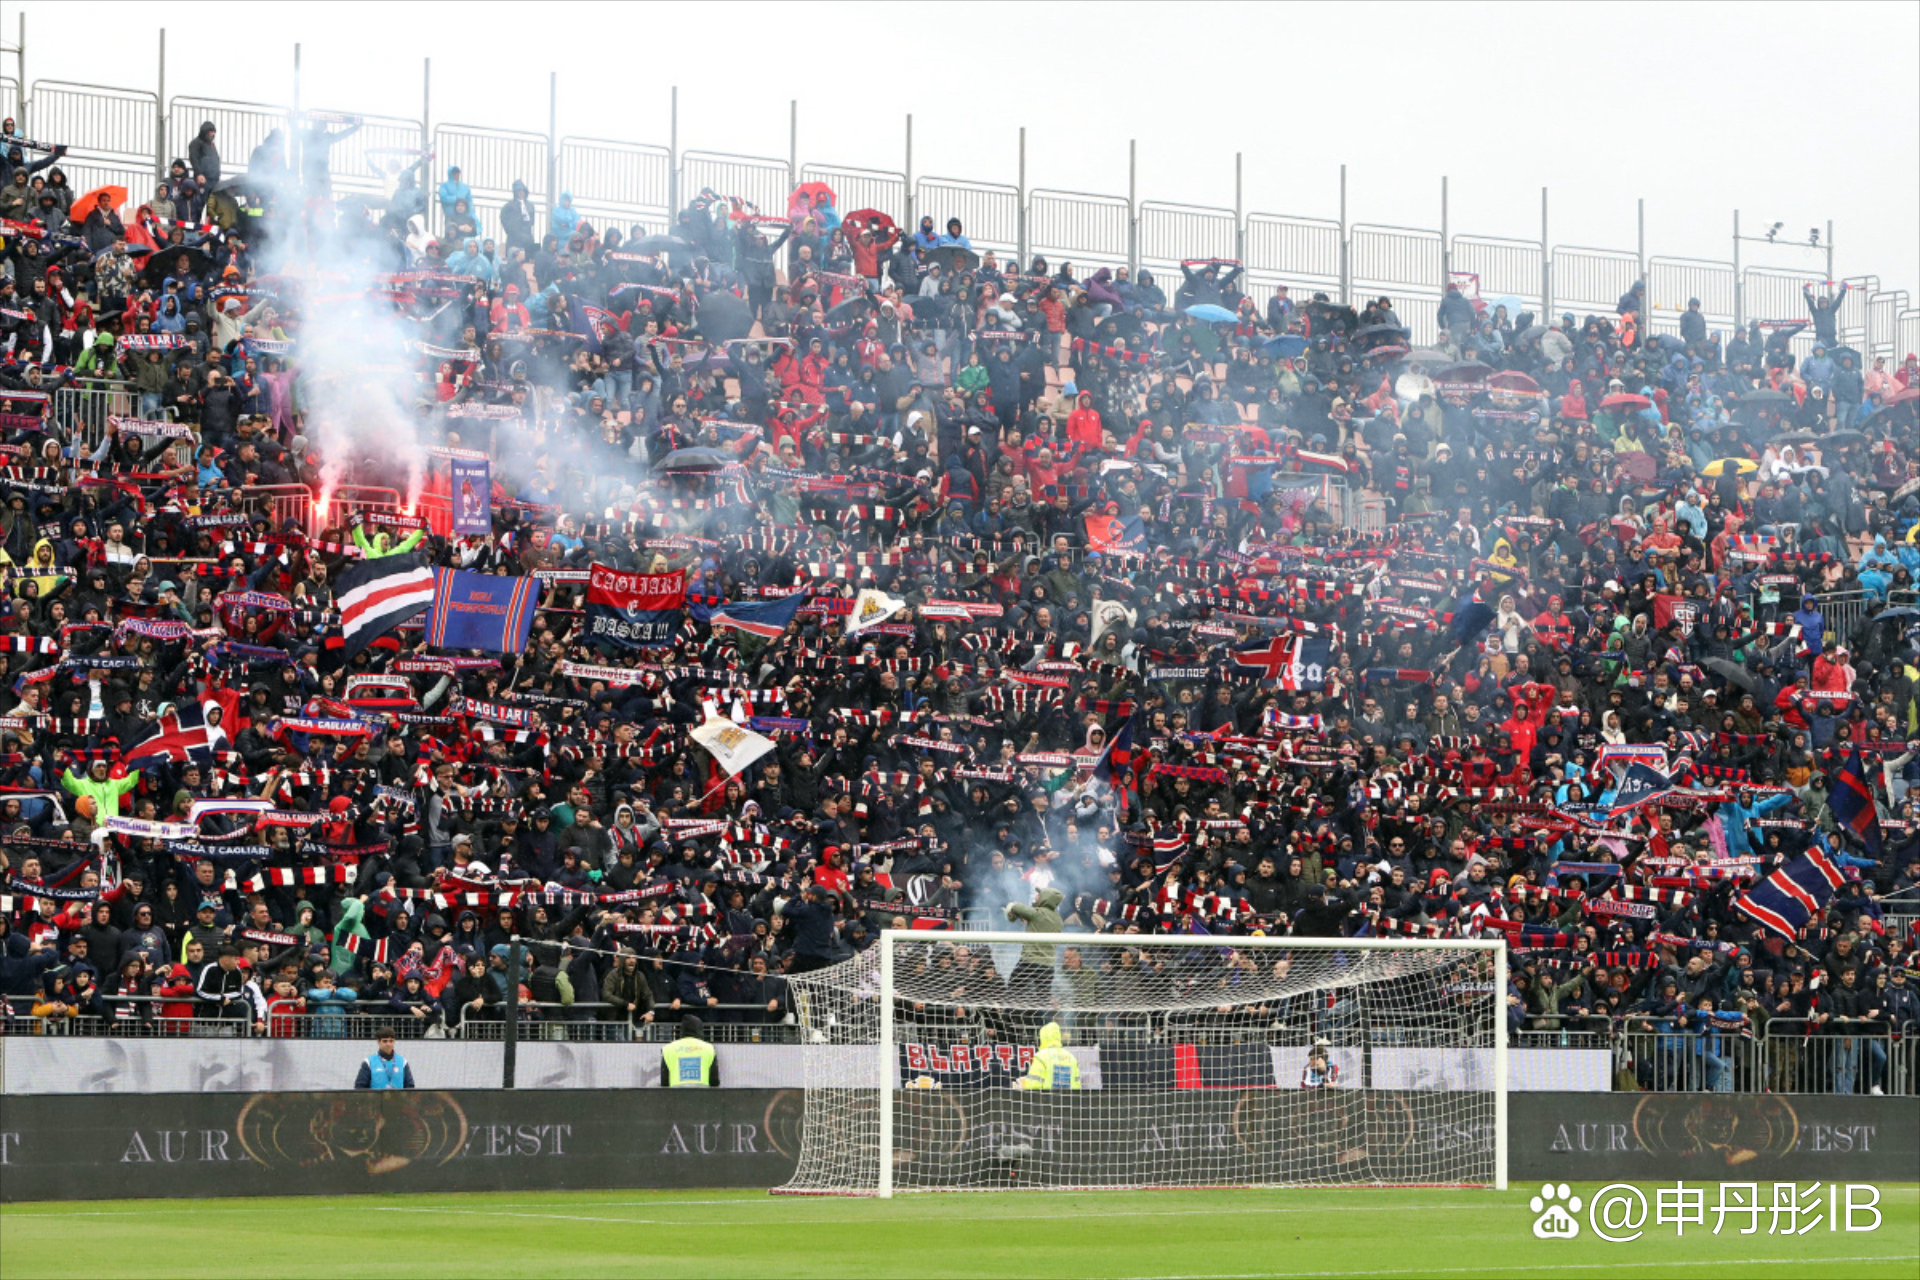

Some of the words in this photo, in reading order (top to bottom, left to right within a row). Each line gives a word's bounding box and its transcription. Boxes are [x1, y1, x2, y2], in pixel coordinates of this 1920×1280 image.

[120, 333, 177, 350] CAGLIARI
[369, 513, 423, 528] CAGLIARI
[645, 540, 691, 551] CAGLIARI
[592, 571, 684, 596] CAGLIARI
[765, 587, 814, 596] CAGLII
[1379, 605, 1425, 619] CAGLIARI
[592, 617, 654, 641] BASTA
[1809, 690, 1853, 700] CAGLIARI
[467, 699, 530, 725] CAGLIARI
[281, 717, 313, 729] FORZA
[317, 720, 362, 731] CAGLIARI
[907, 737, 961, 753] CAGLIARI
[1020, 754, 1067, 765] CAGLIARI
[169, 842, 205, 855] FORZA
[218, 844, 270, 856] CAGLIARI
[1644, 857, 1687, 866] CAGLIARI
[1710, 856, 1761, 866] CAGLIARI
[11, 879, 44, 894] FORZA
[54, 889, 99, 899] CAGLIARI
[605, 883, 669, 903] CAGLIARI
[616, 923, 677, 933] CAGLIARI
[243, 929, 297, 944] CAGLIARI
[660, 1123, 777, 1154] AUR
[1551, 1123, 1641, 1151] AUR
[119, 1129, 250, 1162] AUR
